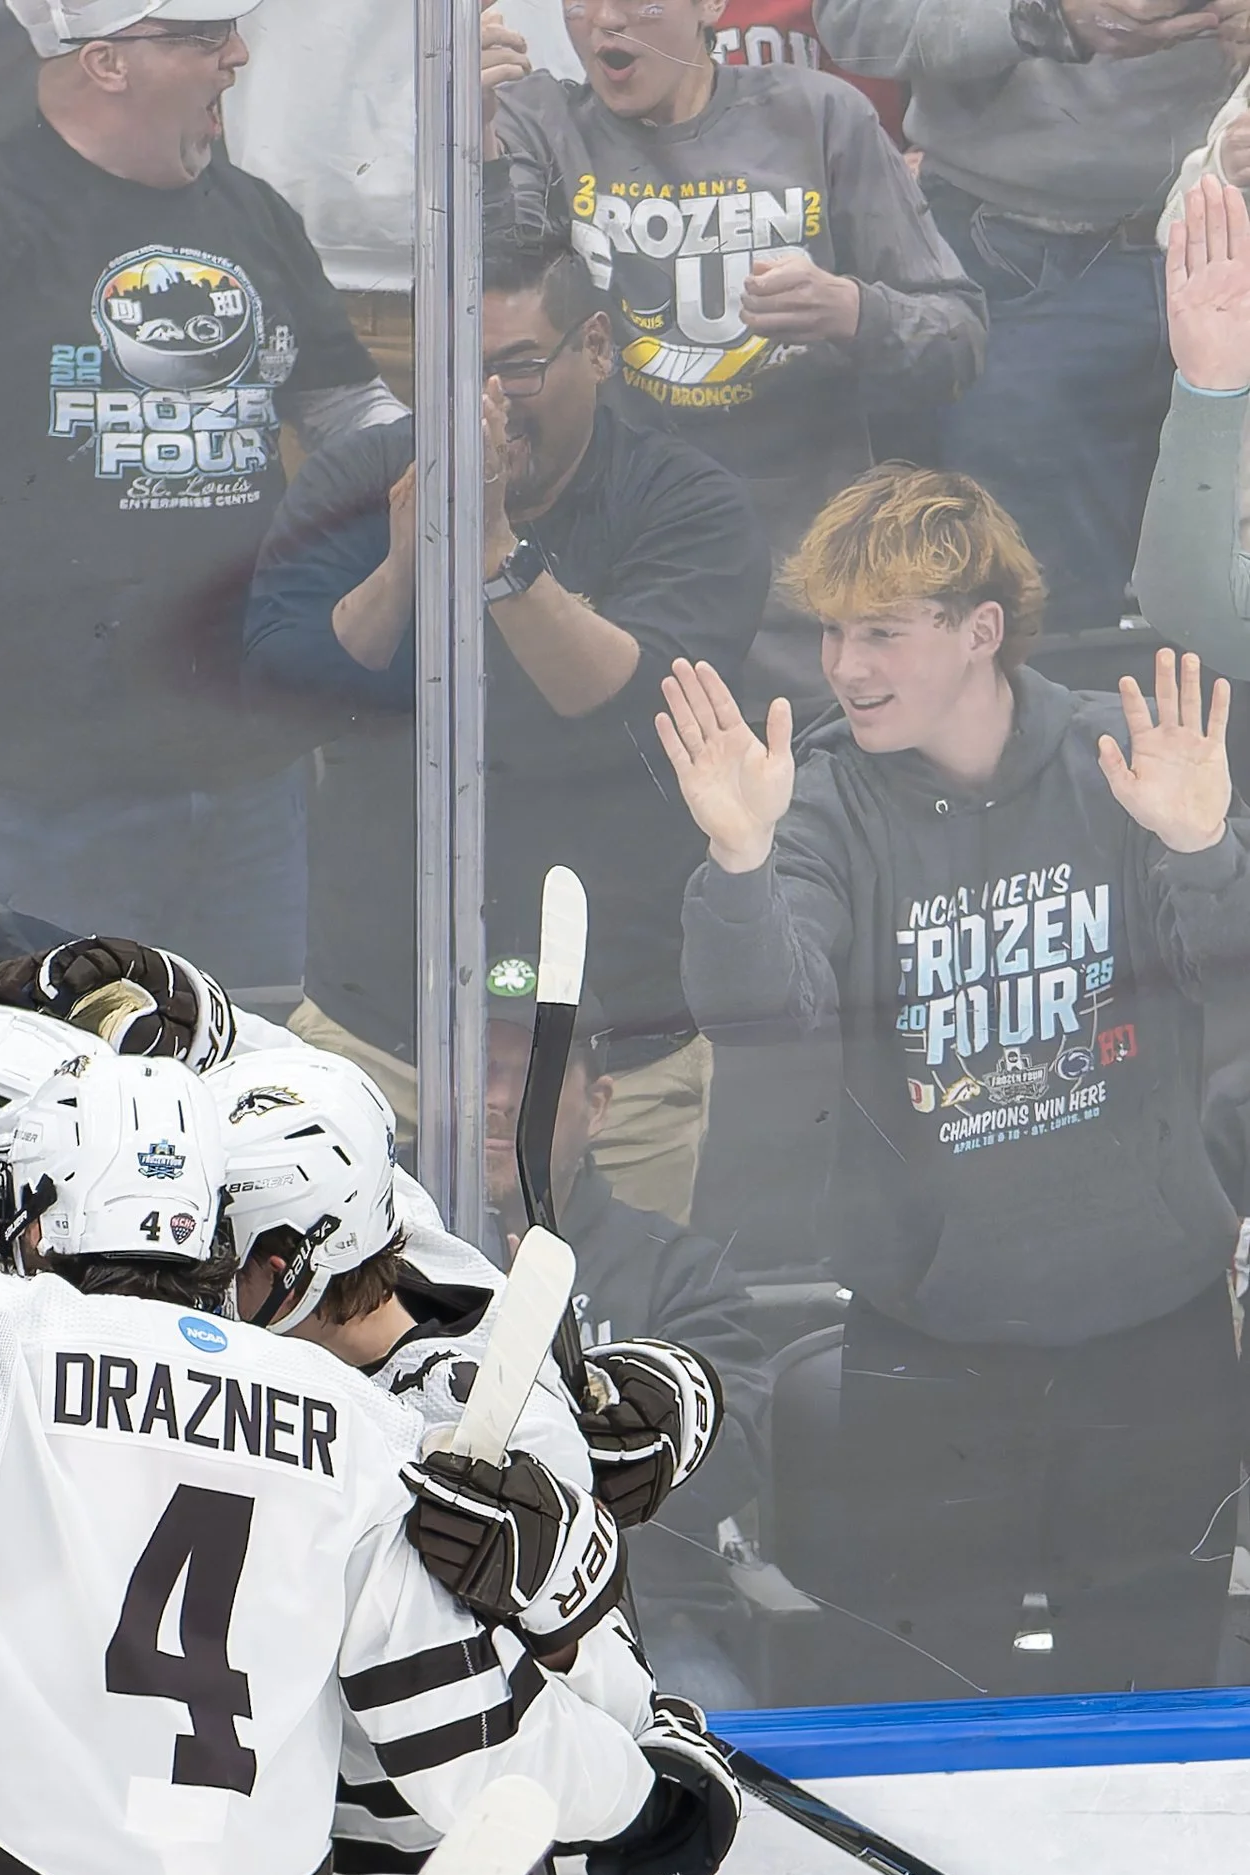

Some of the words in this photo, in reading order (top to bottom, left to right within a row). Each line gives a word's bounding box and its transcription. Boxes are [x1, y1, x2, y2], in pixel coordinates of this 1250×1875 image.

[611, 182, 672, 199] NCAA
[52, 388, 277, 436] FROZE
[98, 430, 268, 475] FOUR
[119, 497, 212, 510] ENTERPRISE
[178, 475, 251, 497] Louis
[896, 884, 1109, 997] FROZEN
[926, 966, 1083, 1066] FOUR
[938, 1103, 1030, 1144] CHAMPIONS
[1034, 1096, 1066, 1123] WIN
[1067, 1080, 1107, 1113] HERE
[228, 1173, 295, 1194] BAUER
[139, 1210, 162, 1242] 4
[186, 1325, 227, 1345] NCAA
[53, 1352, 338, 1478] DRAZNER
[105, 1483, 258, 1798] 4
